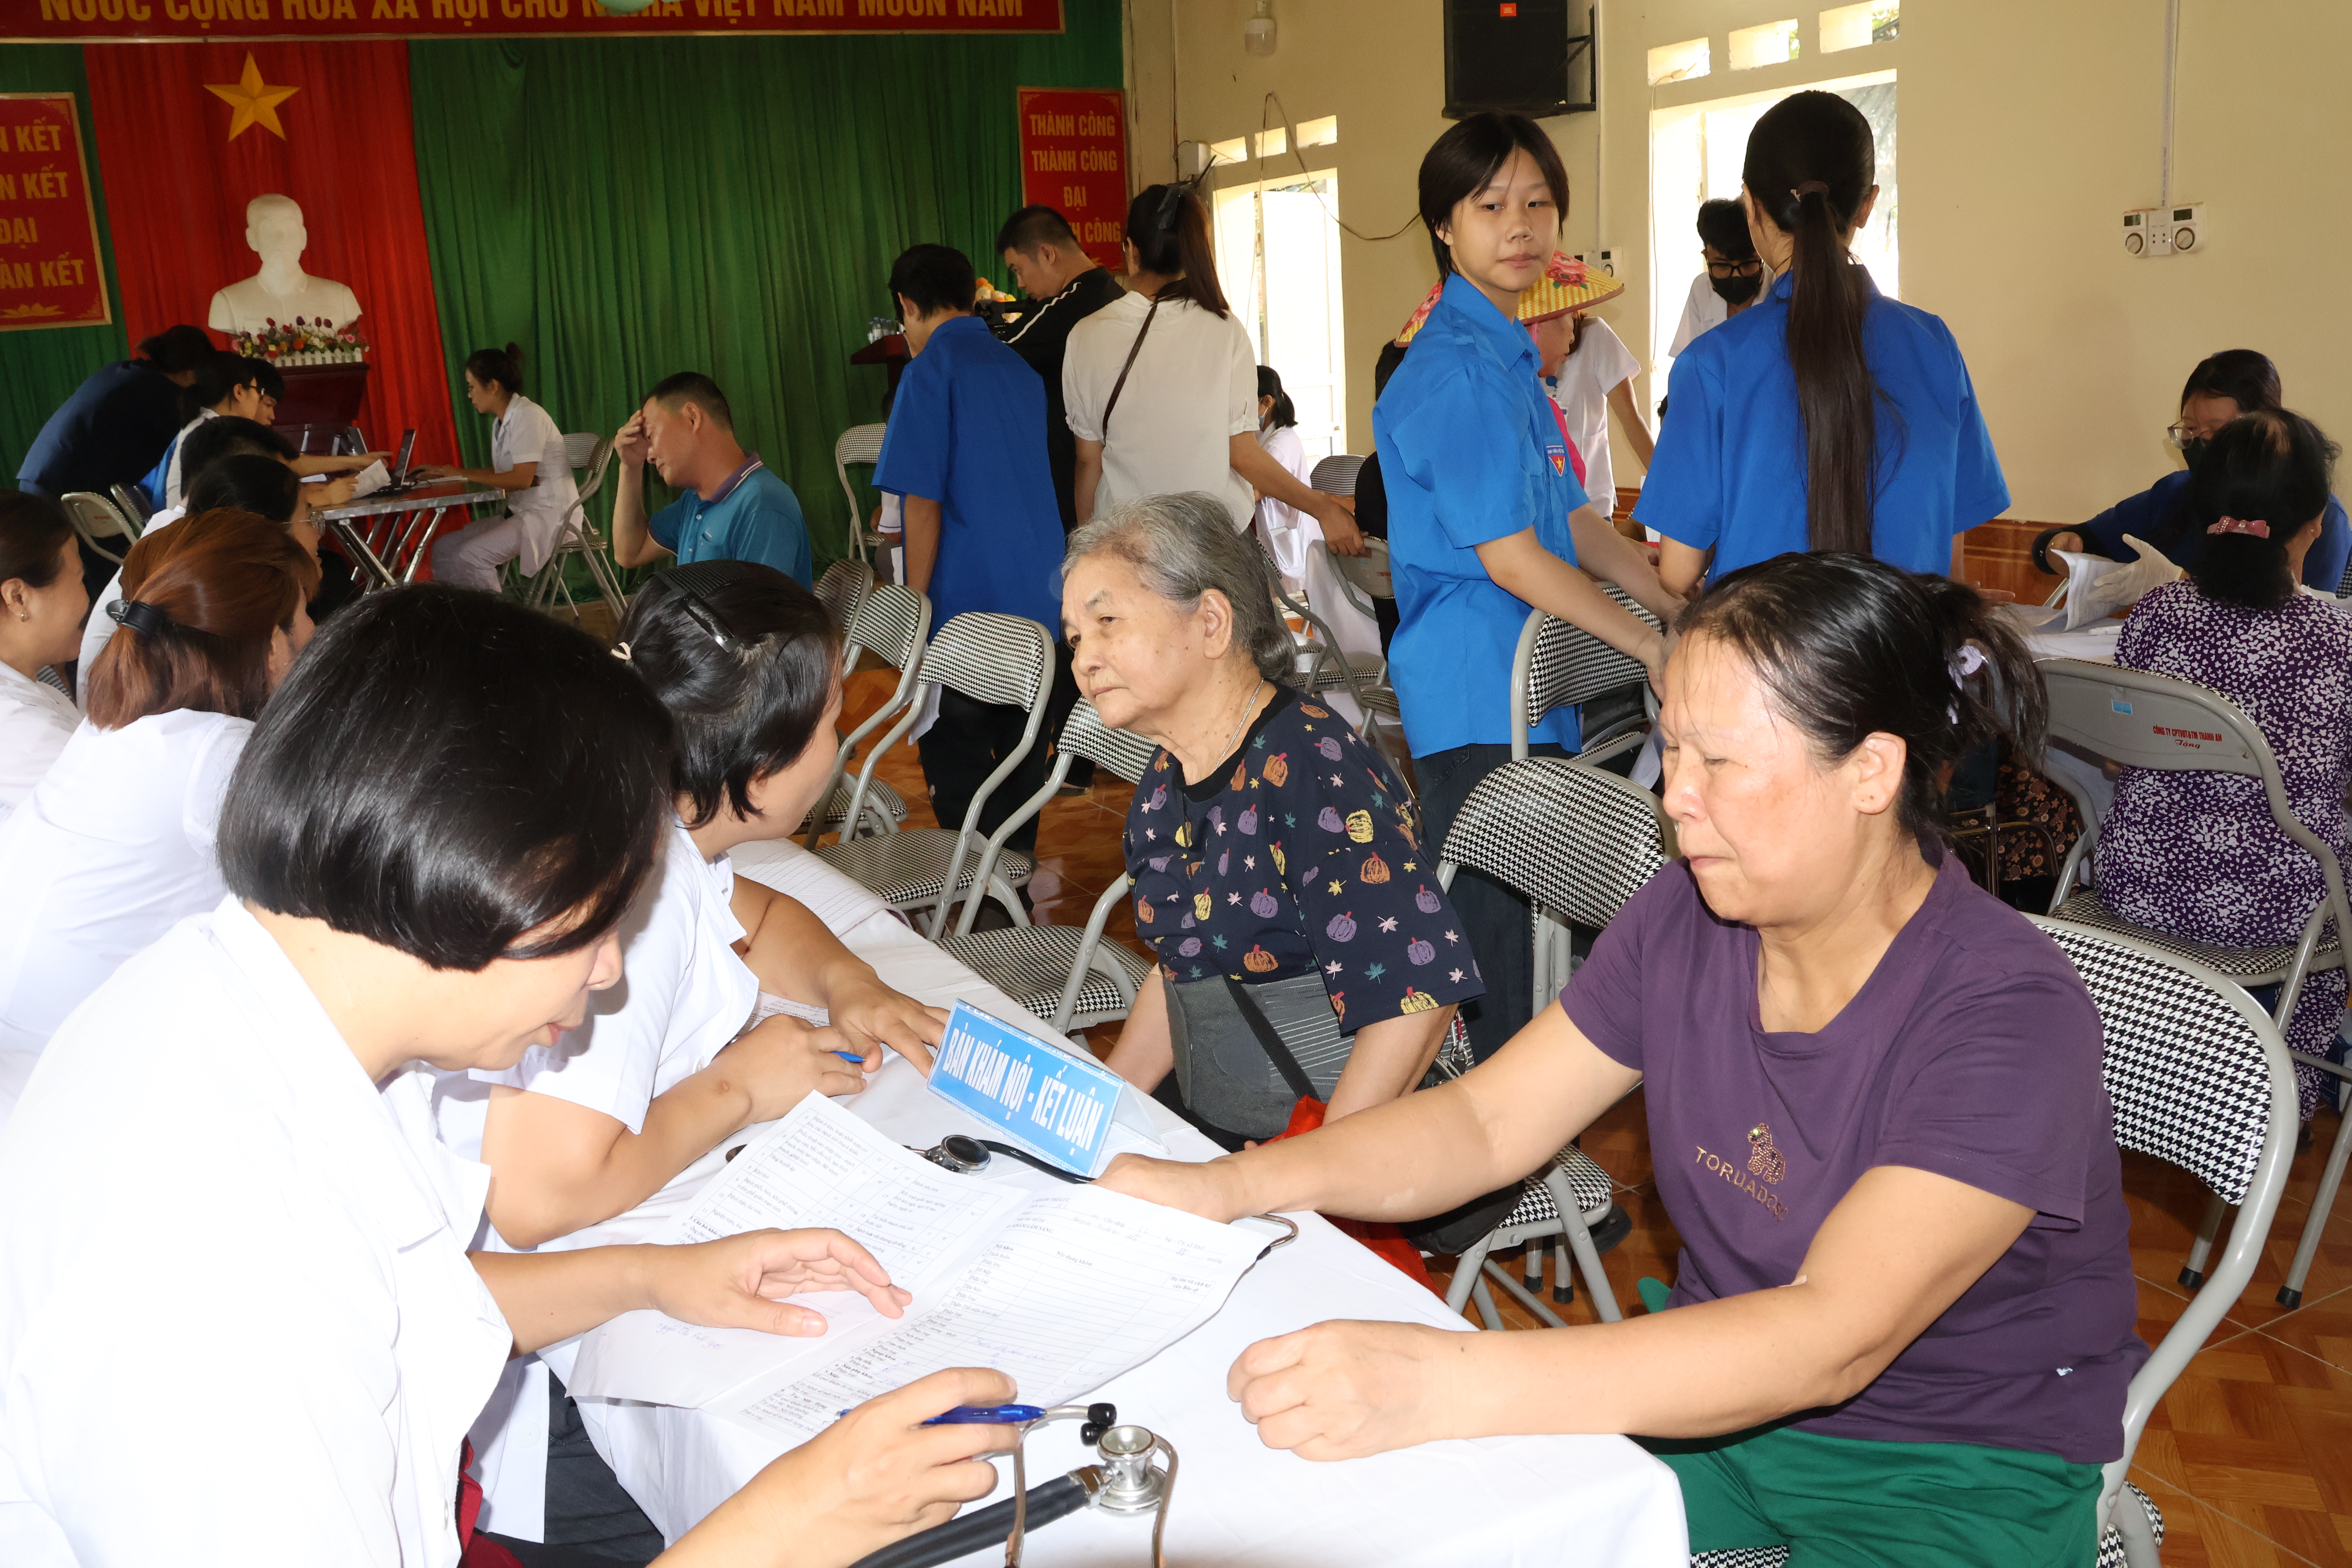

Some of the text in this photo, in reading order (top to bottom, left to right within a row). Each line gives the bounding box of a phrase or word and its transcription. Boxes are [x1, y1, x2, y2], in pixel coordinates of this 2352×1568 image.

[15, 117, 61, 152] KẾT
[1029, 111, 1115, 136] THÀNH CÔNG
[1032, 145, 1117, 171] THÀNH CÔNG
[23, 165, 67, 198] KẾT
[1063, 186, 1087, 211] ĐẠI
[1085, 217, 1121, 242] CÔNG
[40, 252, 84, 287] KẾT
[2153, 724, 2165, 735] CÔNG
[2175, 739, 2201, 749] Tặng
[942, 1022, 975, 1080] BÀN
[964, 1039, 1010, 1100] KHÁM
[999, 1054, 1034, 1120] NỘI
[1031, 1065, 1068, 1131] KẾT
[1056, 1087, 1104, 1156] LUẬN
